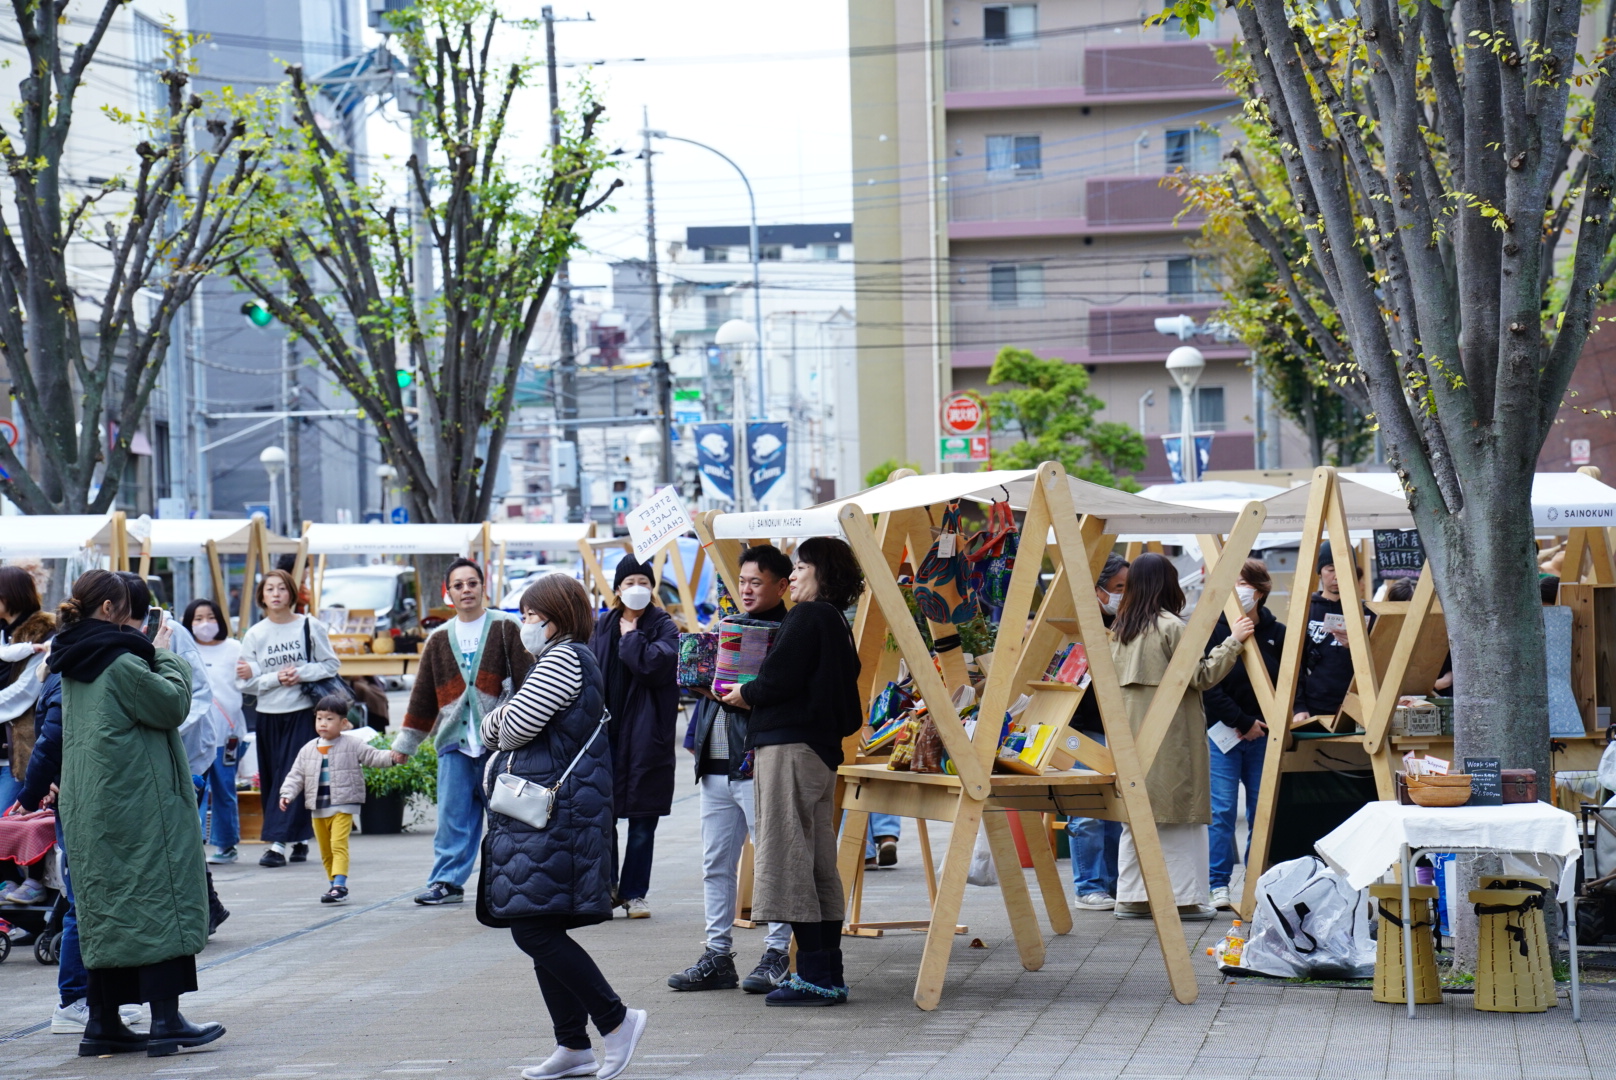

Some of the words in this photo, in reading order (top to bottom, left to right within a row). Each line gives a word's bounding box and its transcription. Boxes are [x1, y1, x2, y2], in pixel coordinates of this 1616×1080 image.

[1564, 509, 1613, 518] SAINOKUNI
[757, 518, 781, 528] SAINOKUNI
[783, 517, 802, 527] MARCHE
[1378, 551, 1422, 567] 新鮮野菜
[267, 640, 301, 655] BANKS
